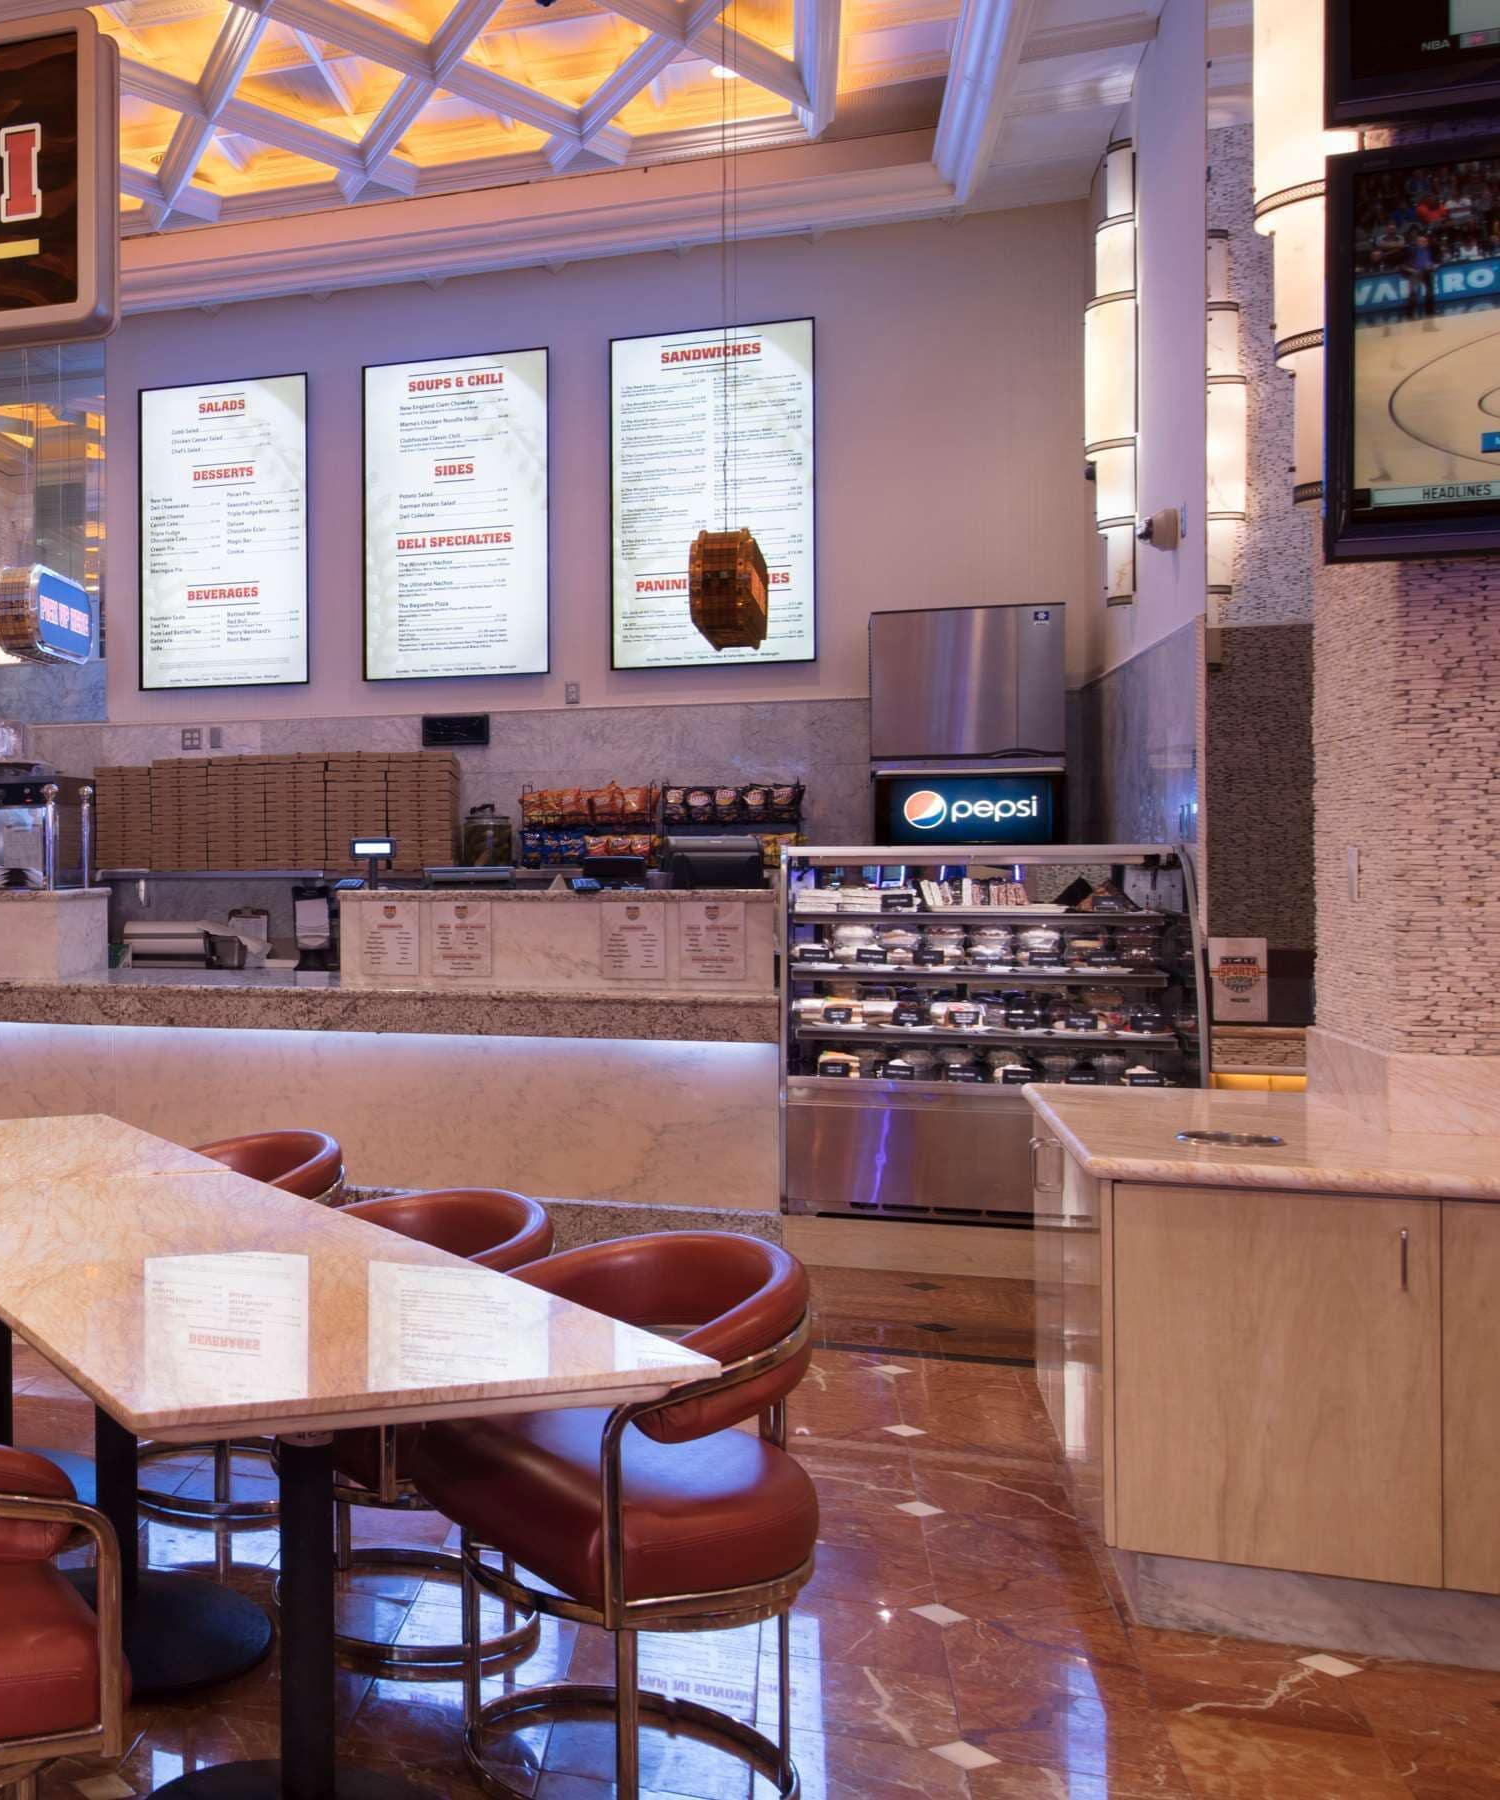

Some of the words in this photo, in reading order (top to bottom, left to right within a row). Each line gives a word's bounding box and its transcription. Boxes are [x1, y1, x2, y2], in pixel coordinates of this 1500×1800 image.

[1421, 39, 1451, 51] NBA
[661, 342, 762, 364] SANDWICHES
[408, 377, 452, 393] SOUPS
[455, 376, 464, 388] &
[467, 372, 504, 387] CHILI
[198, 398, 245, 414] SALADS
[192, 466, 254, 481] DESSERTS
[434, 463, 474, 477] SIDES
[1422, 483, 1492, 500] HEADLINES
[397, 537, 426, 550] DELI
[430, 531, 512, 548] SPECIALTIES
[635, 578, 688, 593] PANINI
[187, 586, 259, 601] BEVERAGES
[950, 795, 1039, 823] pepsi
[1220, 966, 1258, 978] SPORTS
